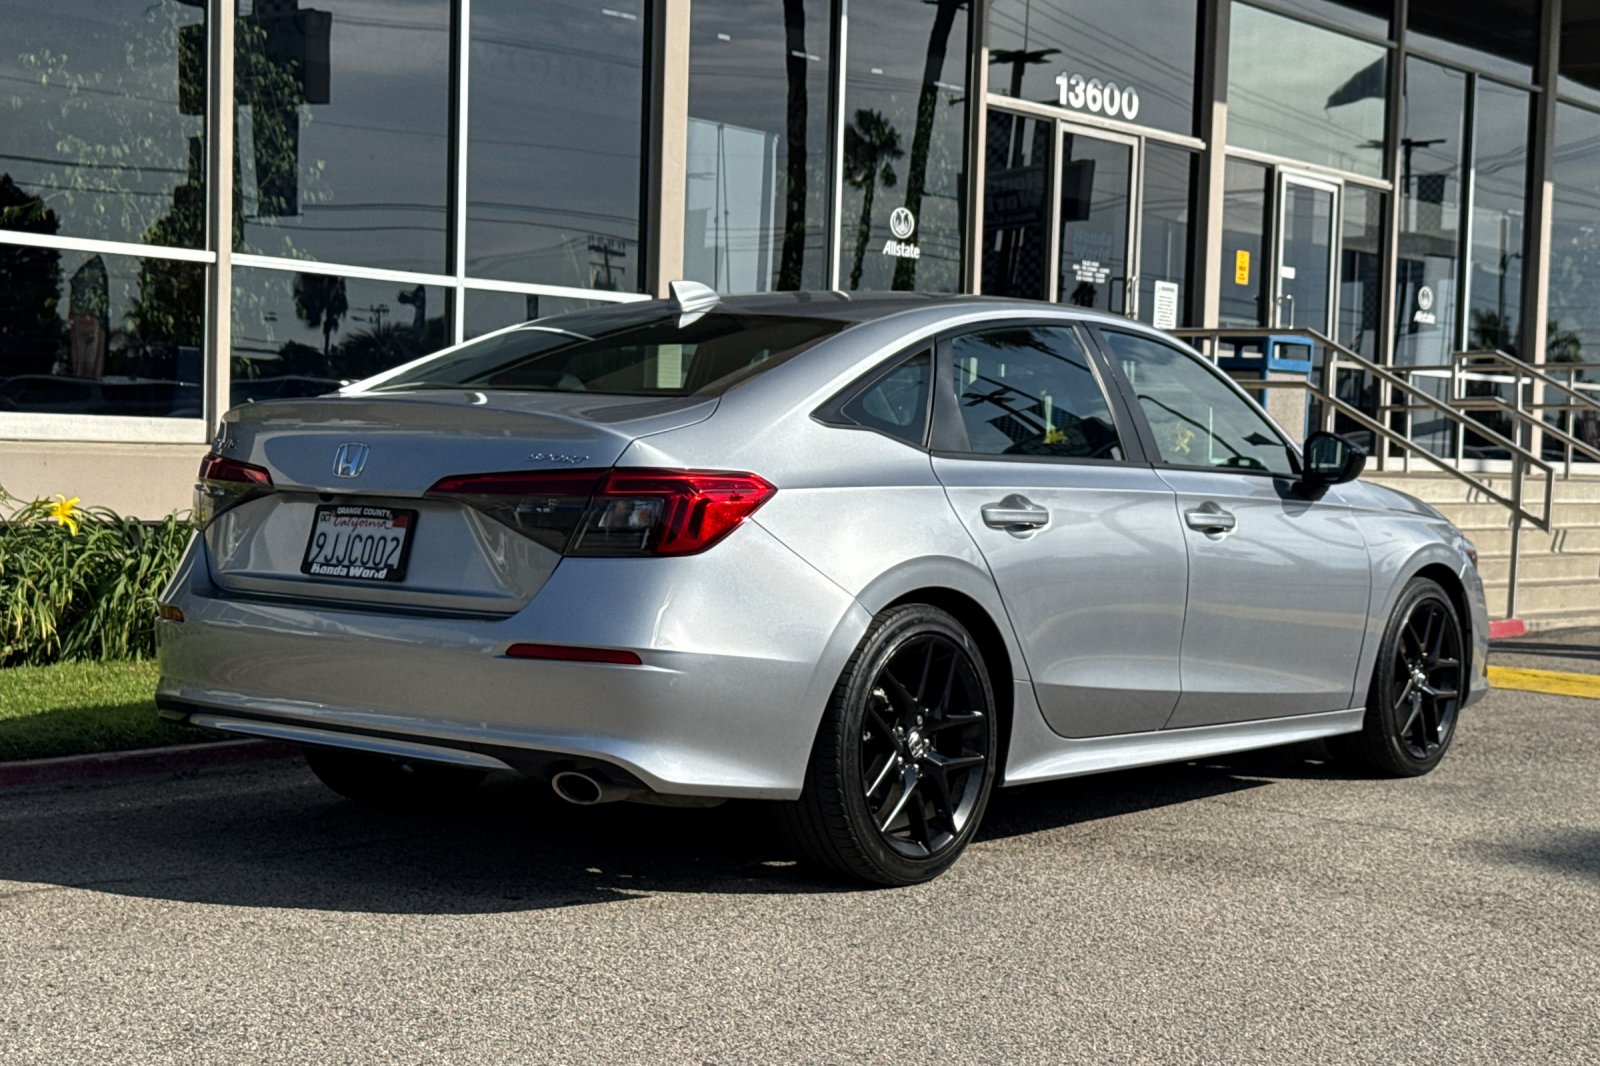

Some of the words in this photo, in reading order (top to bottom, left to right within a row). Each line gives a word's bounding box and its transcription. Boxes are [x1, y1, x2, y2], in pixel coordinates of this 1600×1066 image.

[1056, 72, 1139, 120] 13600
[882, 240, 921, 259] Allstate
[337, 506, 363, 516] ORANGE
[363, 508, 391, 518] COUNTY
[333, 516, 391, 532] California
[312, 532, 401, 567] 9JJC002
[310, 562, 348, 577] Honda
